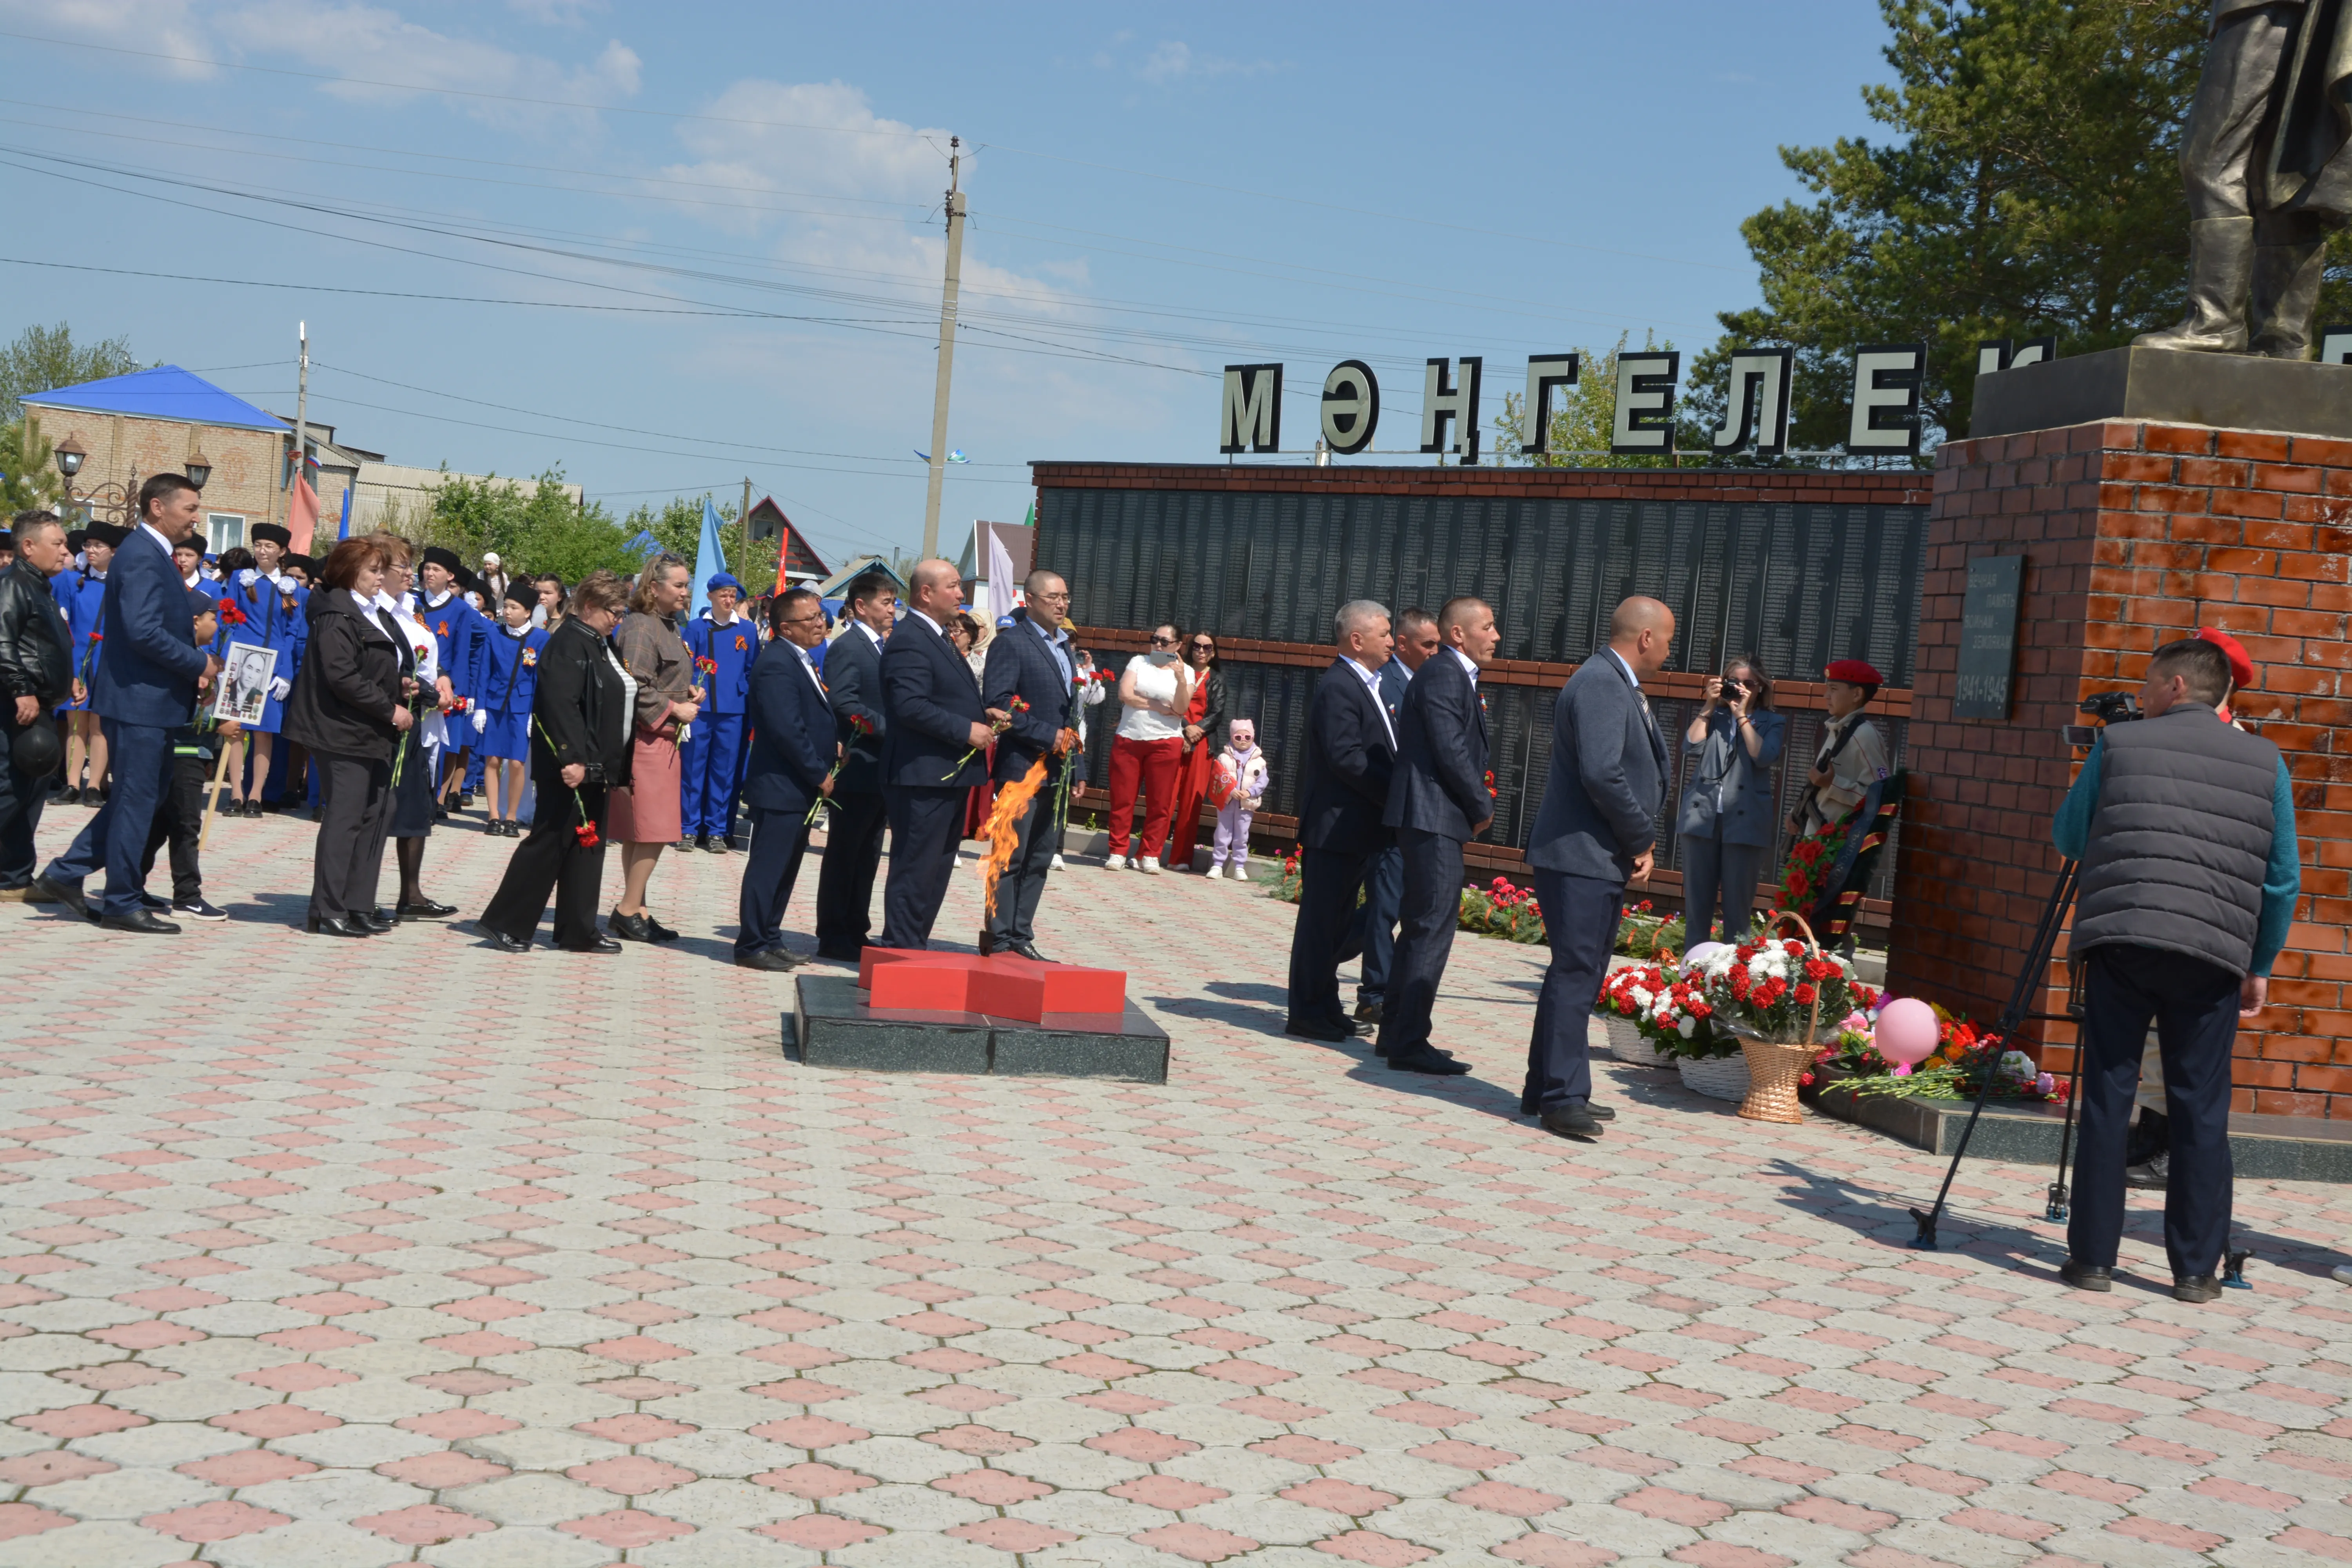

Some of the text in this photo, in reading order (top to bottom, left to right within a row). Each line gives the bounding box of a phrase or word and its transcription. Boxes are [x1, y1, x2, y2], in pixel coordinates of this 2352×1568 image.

[1220, 340, 2051, 463] МӘҢГЕЛЕ
[1968, 573, 1997, 588] ВЕЧНАЯ
[1986, 593, 2015, 608] ПАМЯТЬ
[1958, 674, 2008, 703] 1941-1945
